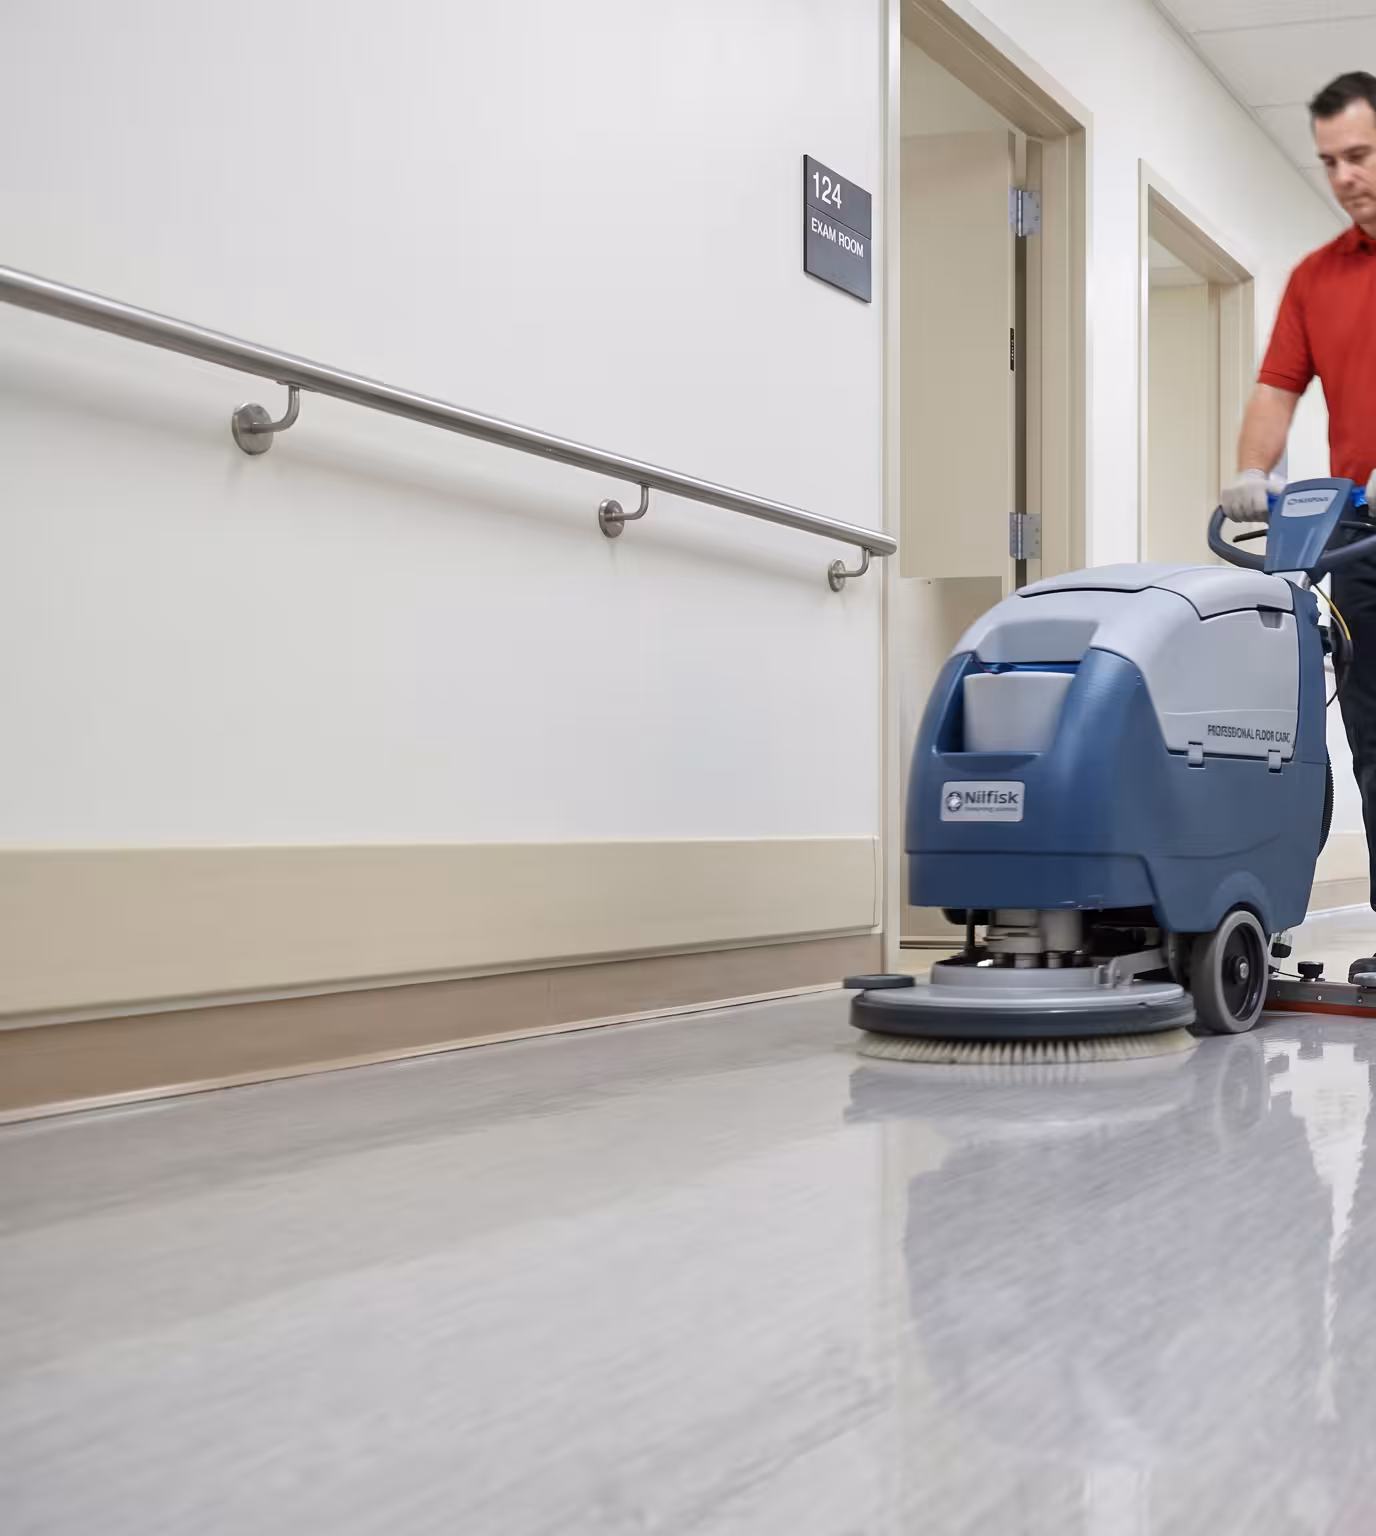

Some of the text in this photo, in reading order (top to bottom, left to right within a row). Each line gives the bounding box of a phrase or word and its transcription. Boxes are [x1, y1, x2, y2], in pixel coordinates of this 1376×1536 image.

[812, 171, 842, 210] 124
[811, 217, 864, 258] EXAM ROOM
[965, 790, 1018, 804] Nilfisk
